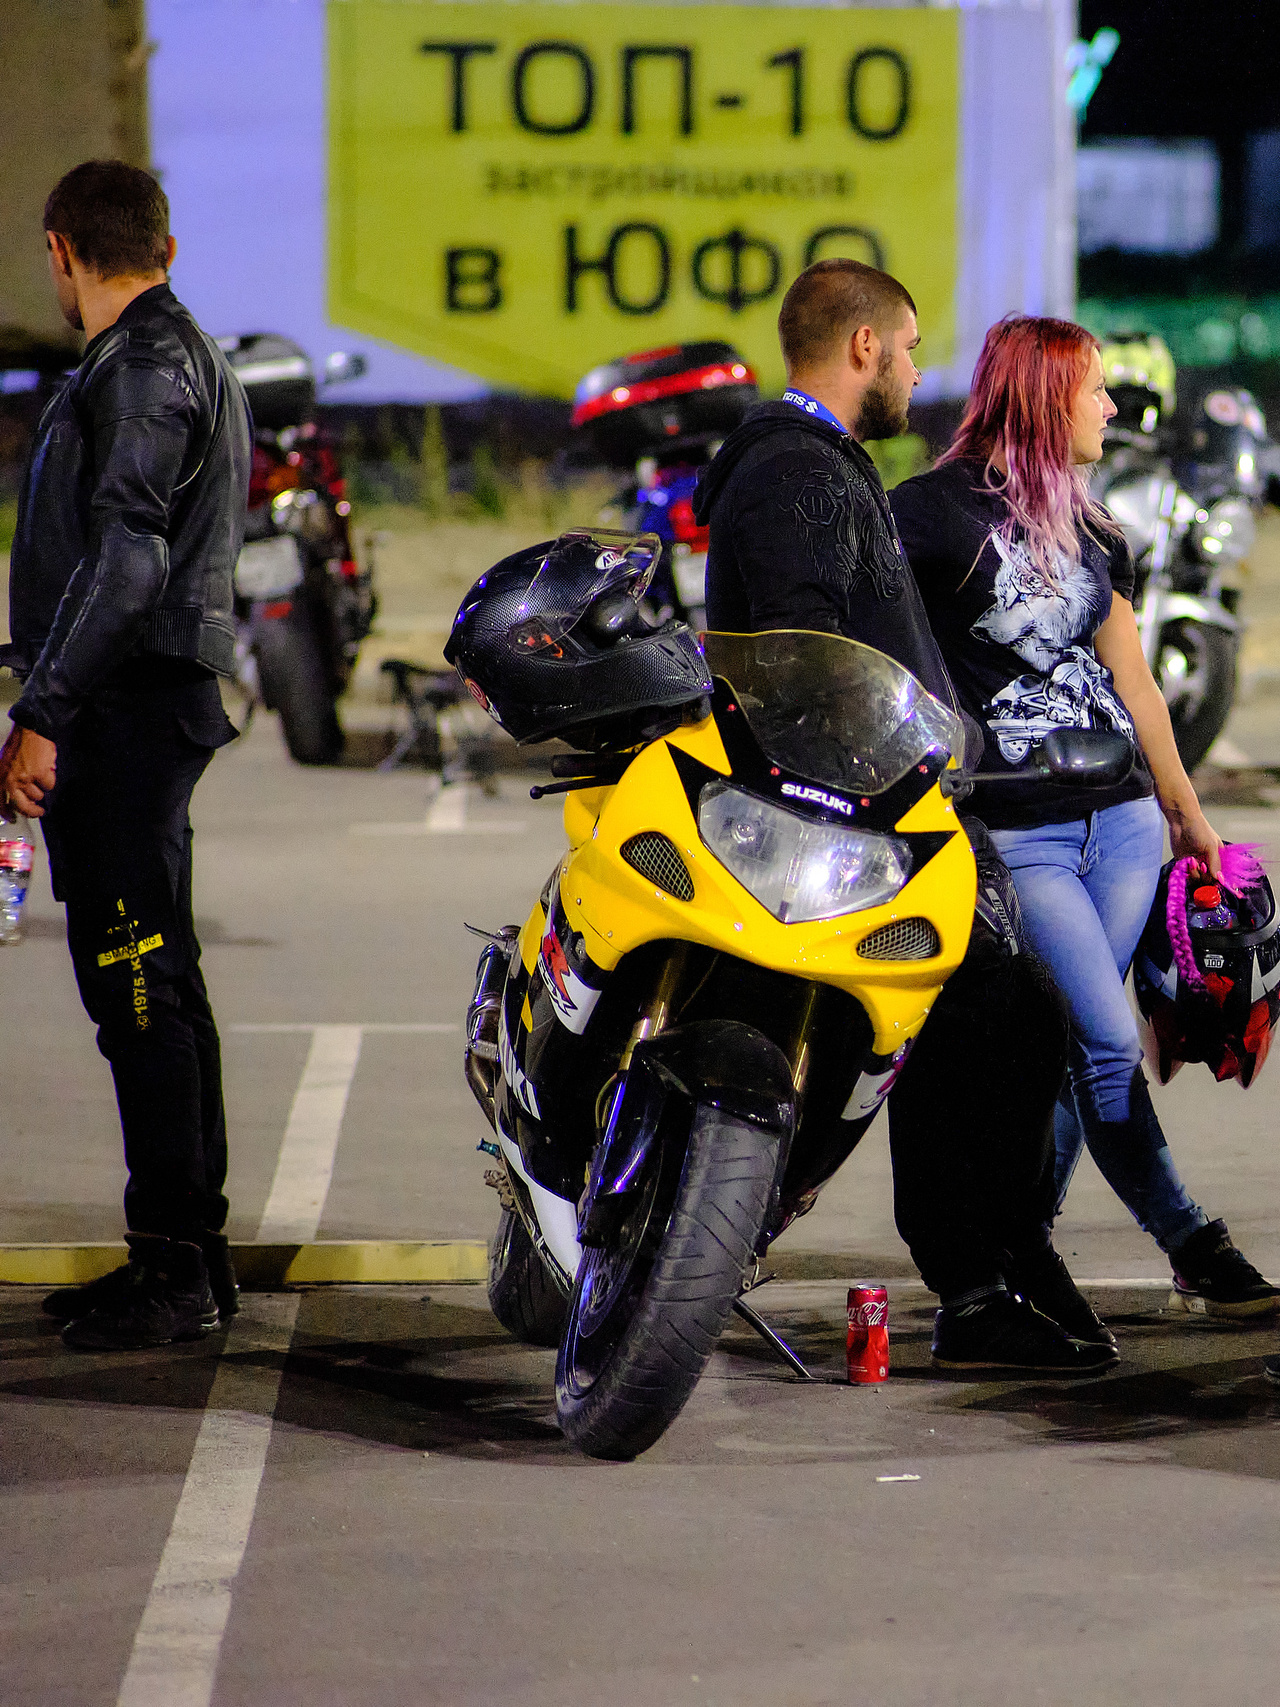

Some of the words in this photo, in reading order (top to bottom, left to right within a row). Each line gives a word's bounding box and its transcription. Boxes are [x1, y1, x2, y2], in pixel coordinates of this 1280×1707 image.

[418, 39, 914, 142] ТОП-10
[443, 246, 503, 313] в
[781, 783, 852, 815] SUZUKI
